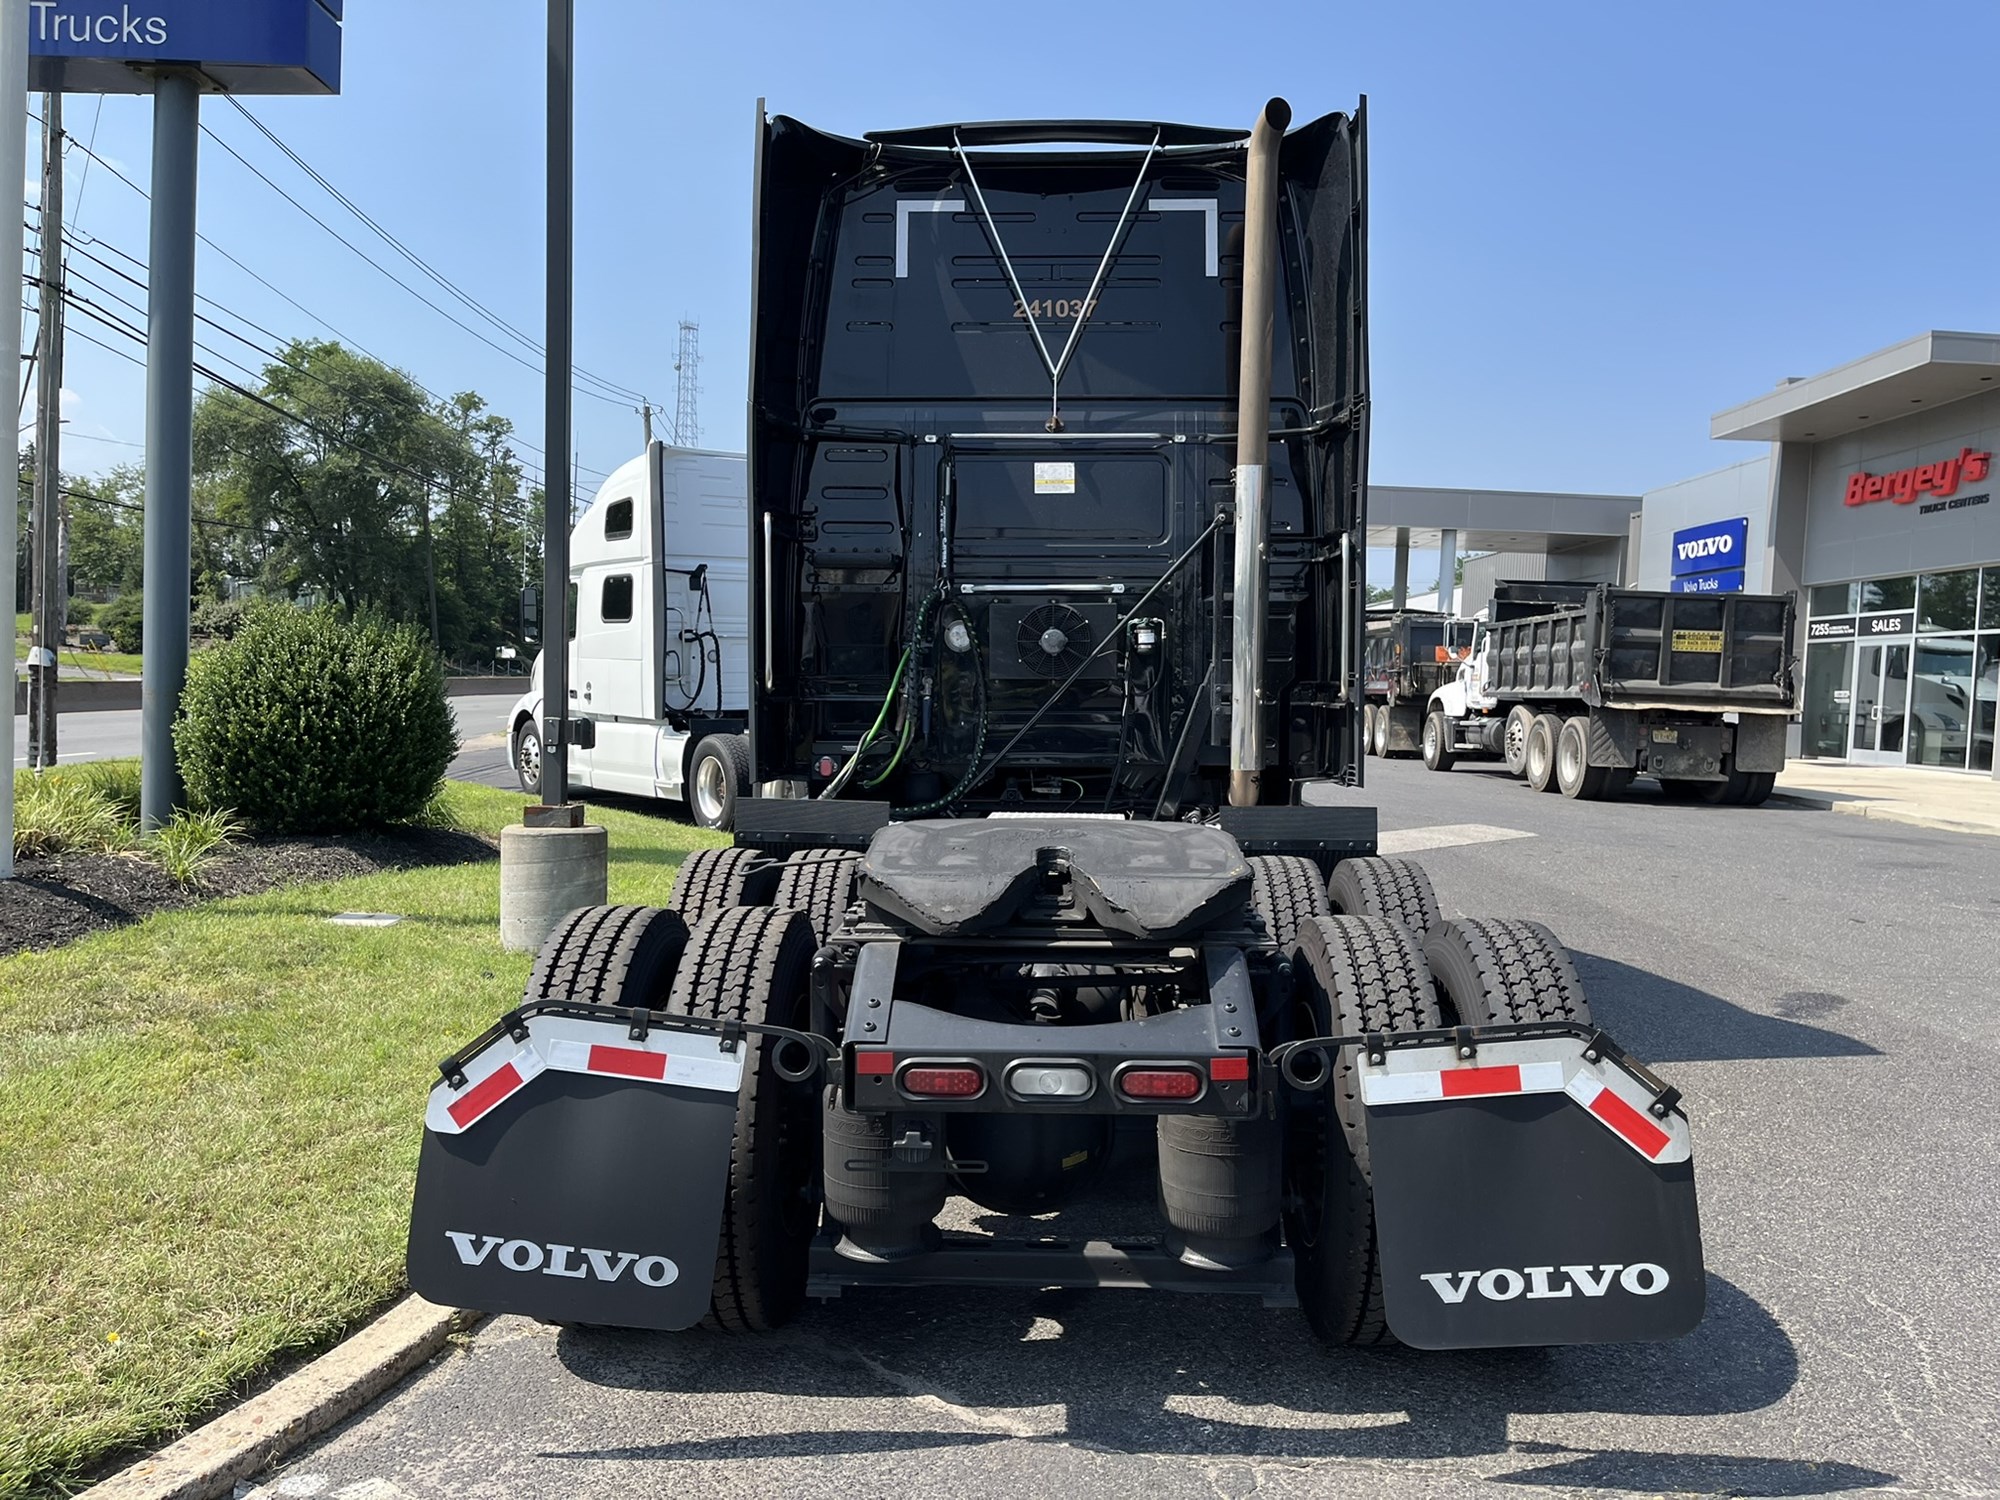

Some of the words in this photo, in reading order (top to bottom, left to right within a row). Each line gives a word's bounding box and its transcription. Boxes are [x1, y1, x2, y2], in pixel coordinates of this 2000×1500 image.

[30, 1, 168, 45] Trucks
[1013, 299, 1098, 318] 241037
[1844, 447, 1992, 507] Bergey's
[1919, 501, 1947, 515] TRUCK
[1948, 493, 1990, 509] CENTERS
[1677, 534, 1733, 560] VOLVO
[1683, 581, 1698, 593] Volvo
[1698, 578, 1719, 591] Trucks
[1811, 623, 1830, 636] 7255
[1871, 618, 1901, 632] SALES
[445, 1230, 679, 1287] VOLVO
[1420, 1263, 1670, 1304] VOLVO
